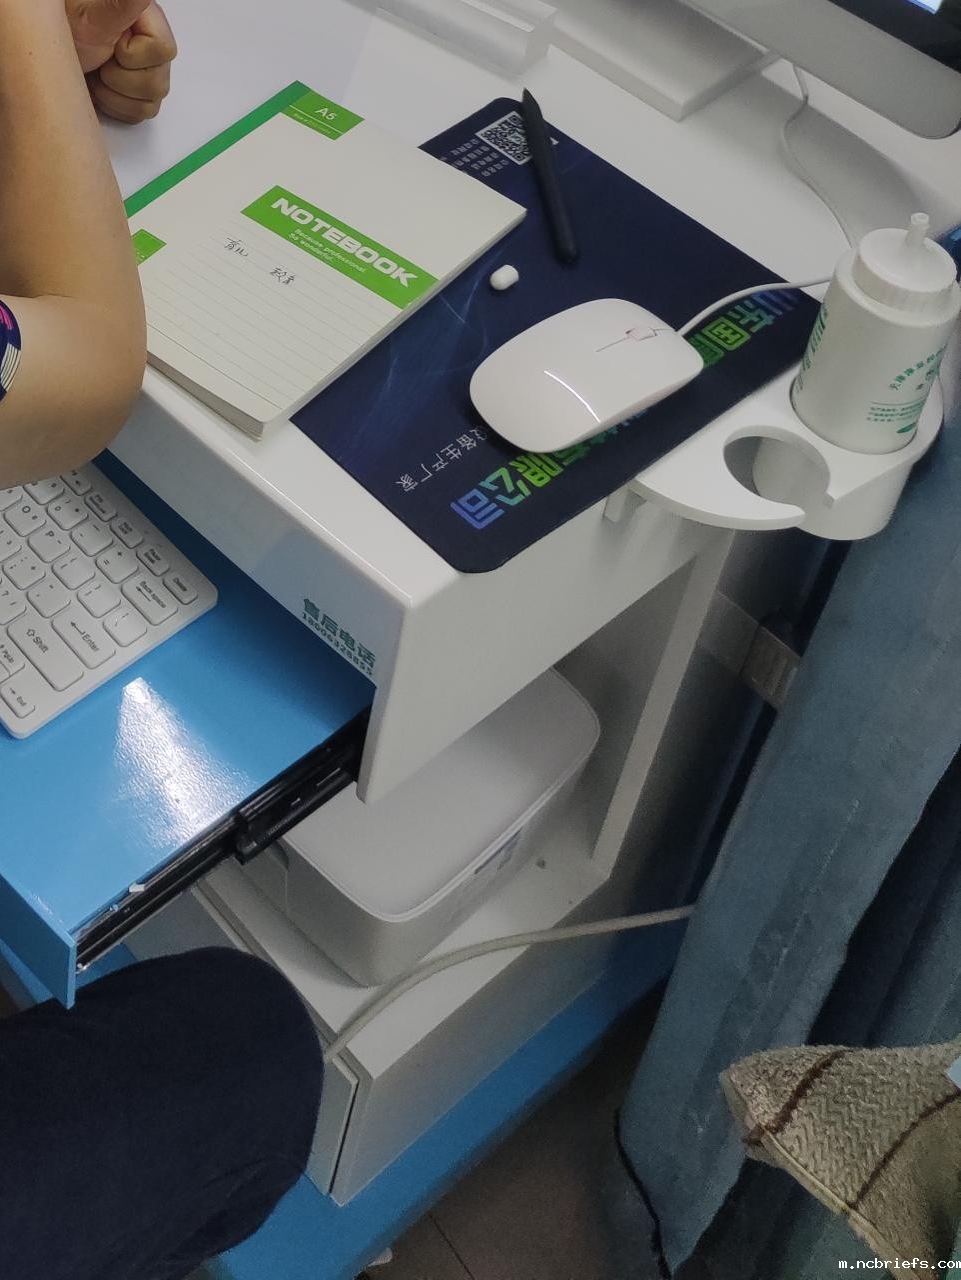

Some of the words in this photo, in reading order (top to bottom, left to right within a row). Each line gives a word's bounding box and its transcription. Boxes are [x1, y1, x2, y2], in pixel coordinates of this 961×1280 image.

[315, 108, 337, 120] A5
[271, 198, 418, 288] NOTEBOOK
[81, 633, 100, 652] Enter
[303, 598, 376, 668] 售后电话
[33, 636, 49, 654] Shift
